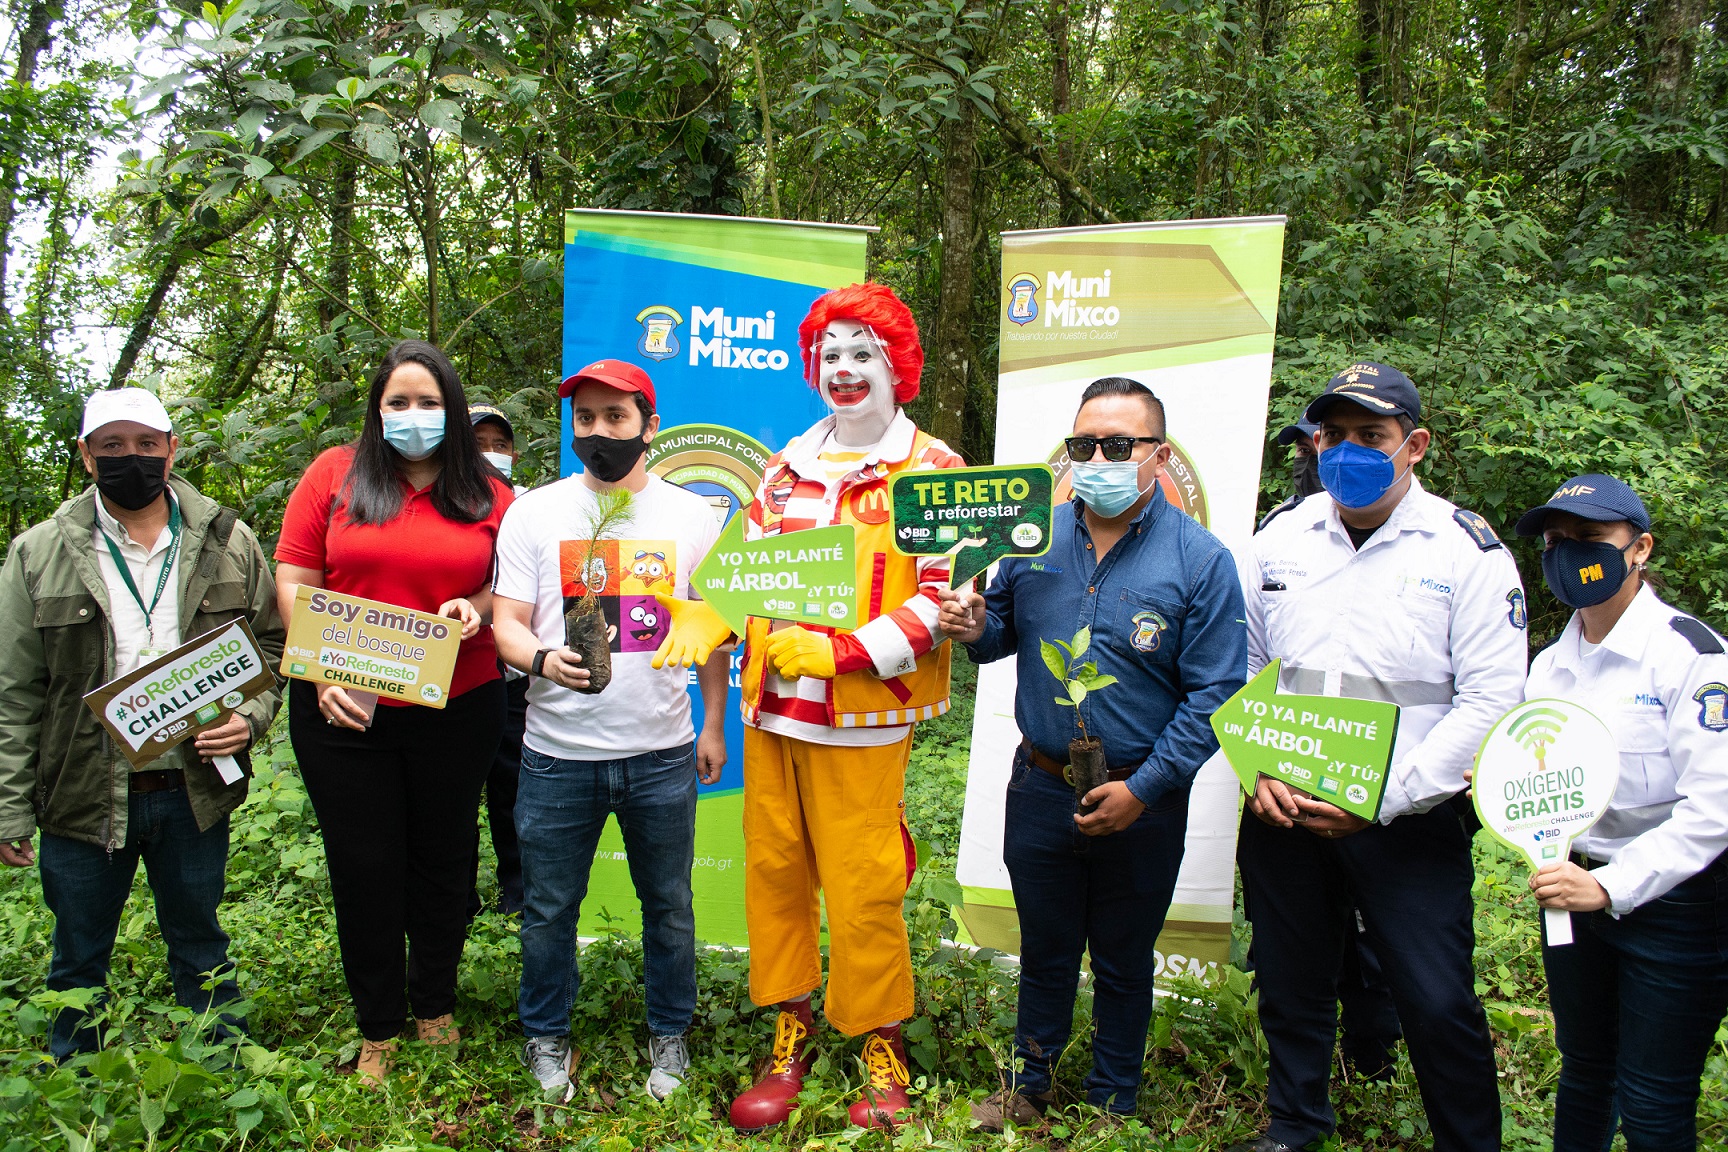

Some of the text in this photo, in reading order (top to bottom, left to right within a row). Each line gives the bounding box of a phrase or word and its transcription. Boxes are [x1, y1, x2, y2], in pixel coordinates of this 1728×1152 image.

[1046, 269, 1111, 298] Muni
[691, 306, 775, 340] Muni
[1044, 299, 1120, 327] Mixco
[689, 336, 790, 371] Mixco
[660, 434, 733, 453] MUNICIPAL
[718, 473, 728, 482] DE
[730, 479, 750, 499] MIXCO
[913, 477, 1030, 506] TE RETO
[924, 503, 1021, 520] a reforestar
[912, 528, 930, 537] BID
[717, 543, 844, 566] YO YA PLANTÉ
[706, 568, 855, 598] UN ÁRBOL ¿Y TÚ?
[1420, 577, 1451, 594] Mixco
[1579, 563, 1604, 585] PM
[309, 592, 449, 640] Soy amigo
[777, 601, 796, 611] BID
[299, 649, 316, 658] BID
[322, 623, 426, 661] del bosque
[116, 639, 242, 721] #YoReforesto
[321, 651, 416, 681] #YoReforesto
[128, 654, 254, 736] CHALLENGE
[323, 669, 405, 694] CHALLENGE
[167, 720, 188, 735] BID
[1241, 698, 1378, 741] YO YA PLANTÉ
[1224, 719, 1381, 783] UN ÁRBOL ¿Y TÚ?
[1292, 765, 1312, 780] BID
[1504, 766, 1585, 801] OXÍGENO
[1505, 790, 1585, 821] GRATIS
[1551, 811, 1595, 825] CHALLENGE
[1545, 828, 1561, 838] BID
